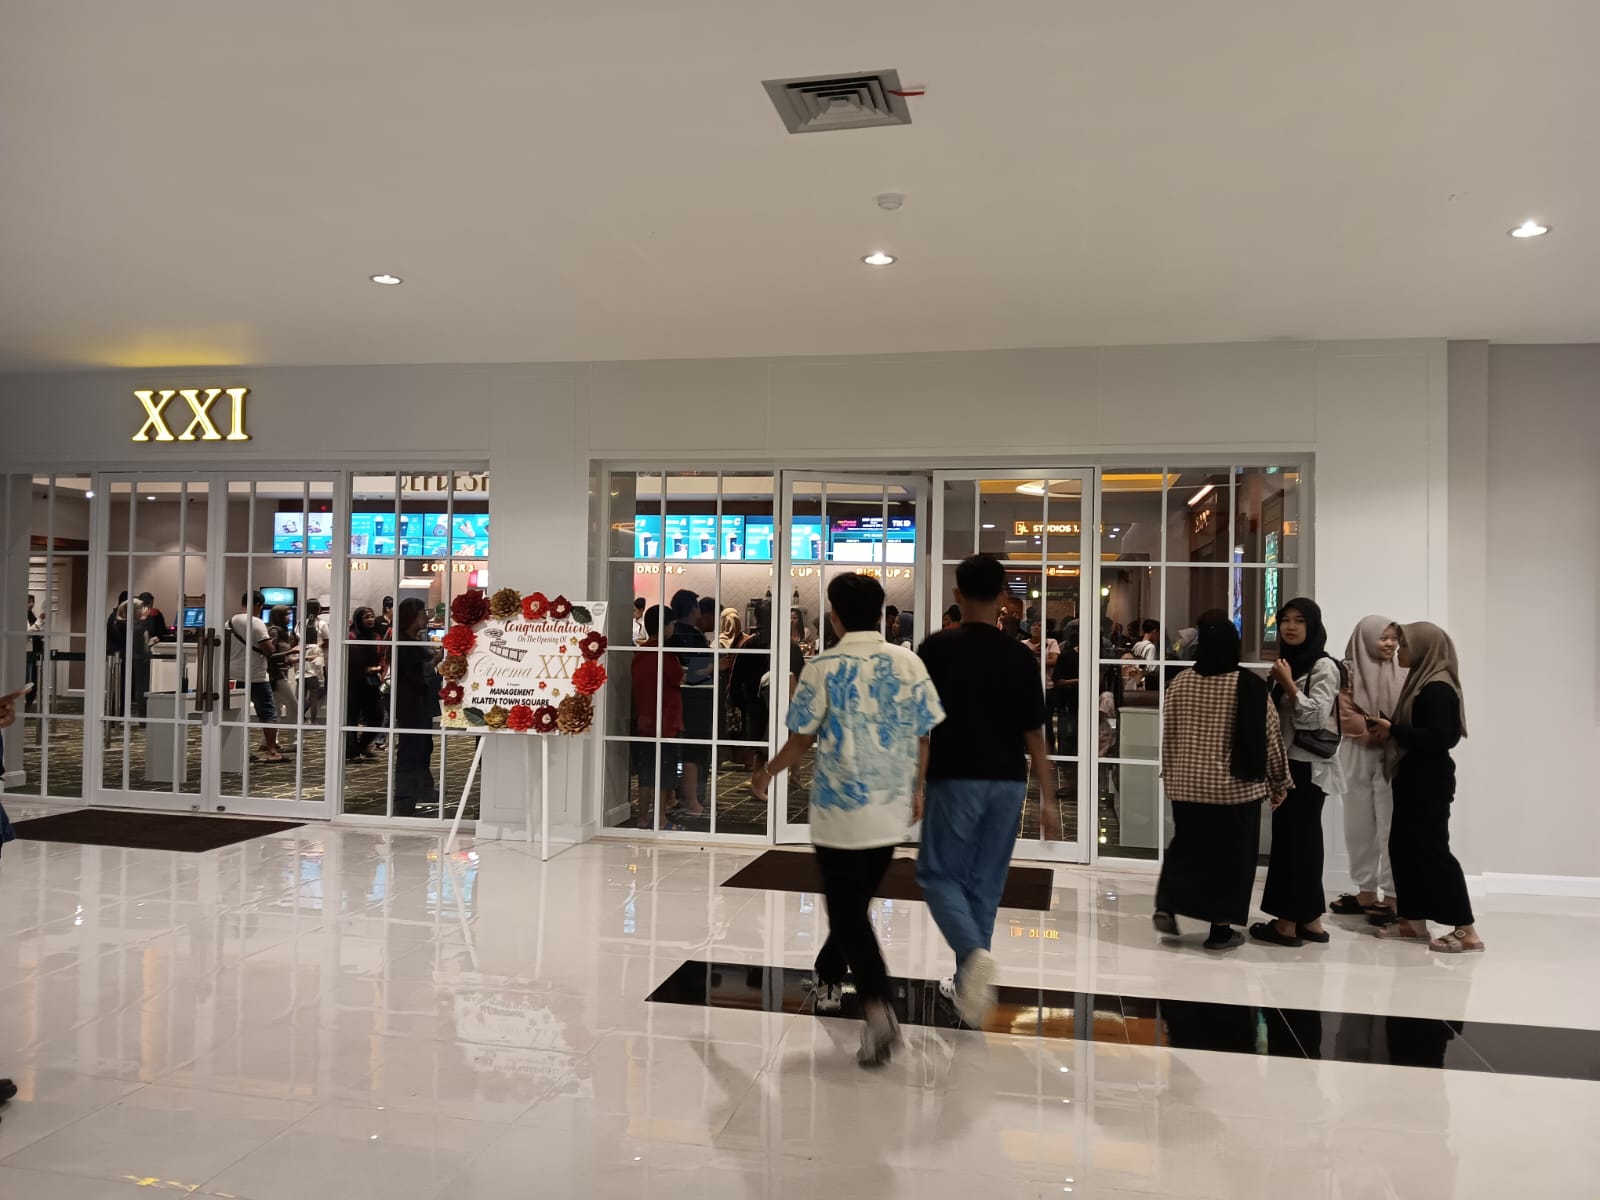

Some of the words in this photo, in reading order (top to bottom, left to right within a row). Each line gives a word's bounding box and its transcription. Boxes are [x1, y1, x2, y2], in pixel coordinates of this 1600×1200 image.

[131, 387, 251, 442] XXI
[431, 563, 466, 572] ORER
[636, 565, 673, 574] ORDR
[798, 568, 813, 577] UP
[856, 568, 882, 578] PICK
[886, 568, 900, 577] UP
[903, 569, 910, 578] 2
[504, 620, 591, 637] Congratulations
[517, 635, 526, 643] On
[526, 635, 536, 643] The
[536, 635, 559, 644] Opening
[472, 651, 533, 679] Cinema
[489, 688, 535, 697] MANAGEMENT
[471, 696, 499, 705] KLATEN
[499, 697, 521, 706] TOWN
[520, 698, 550, 706] SQUARE
